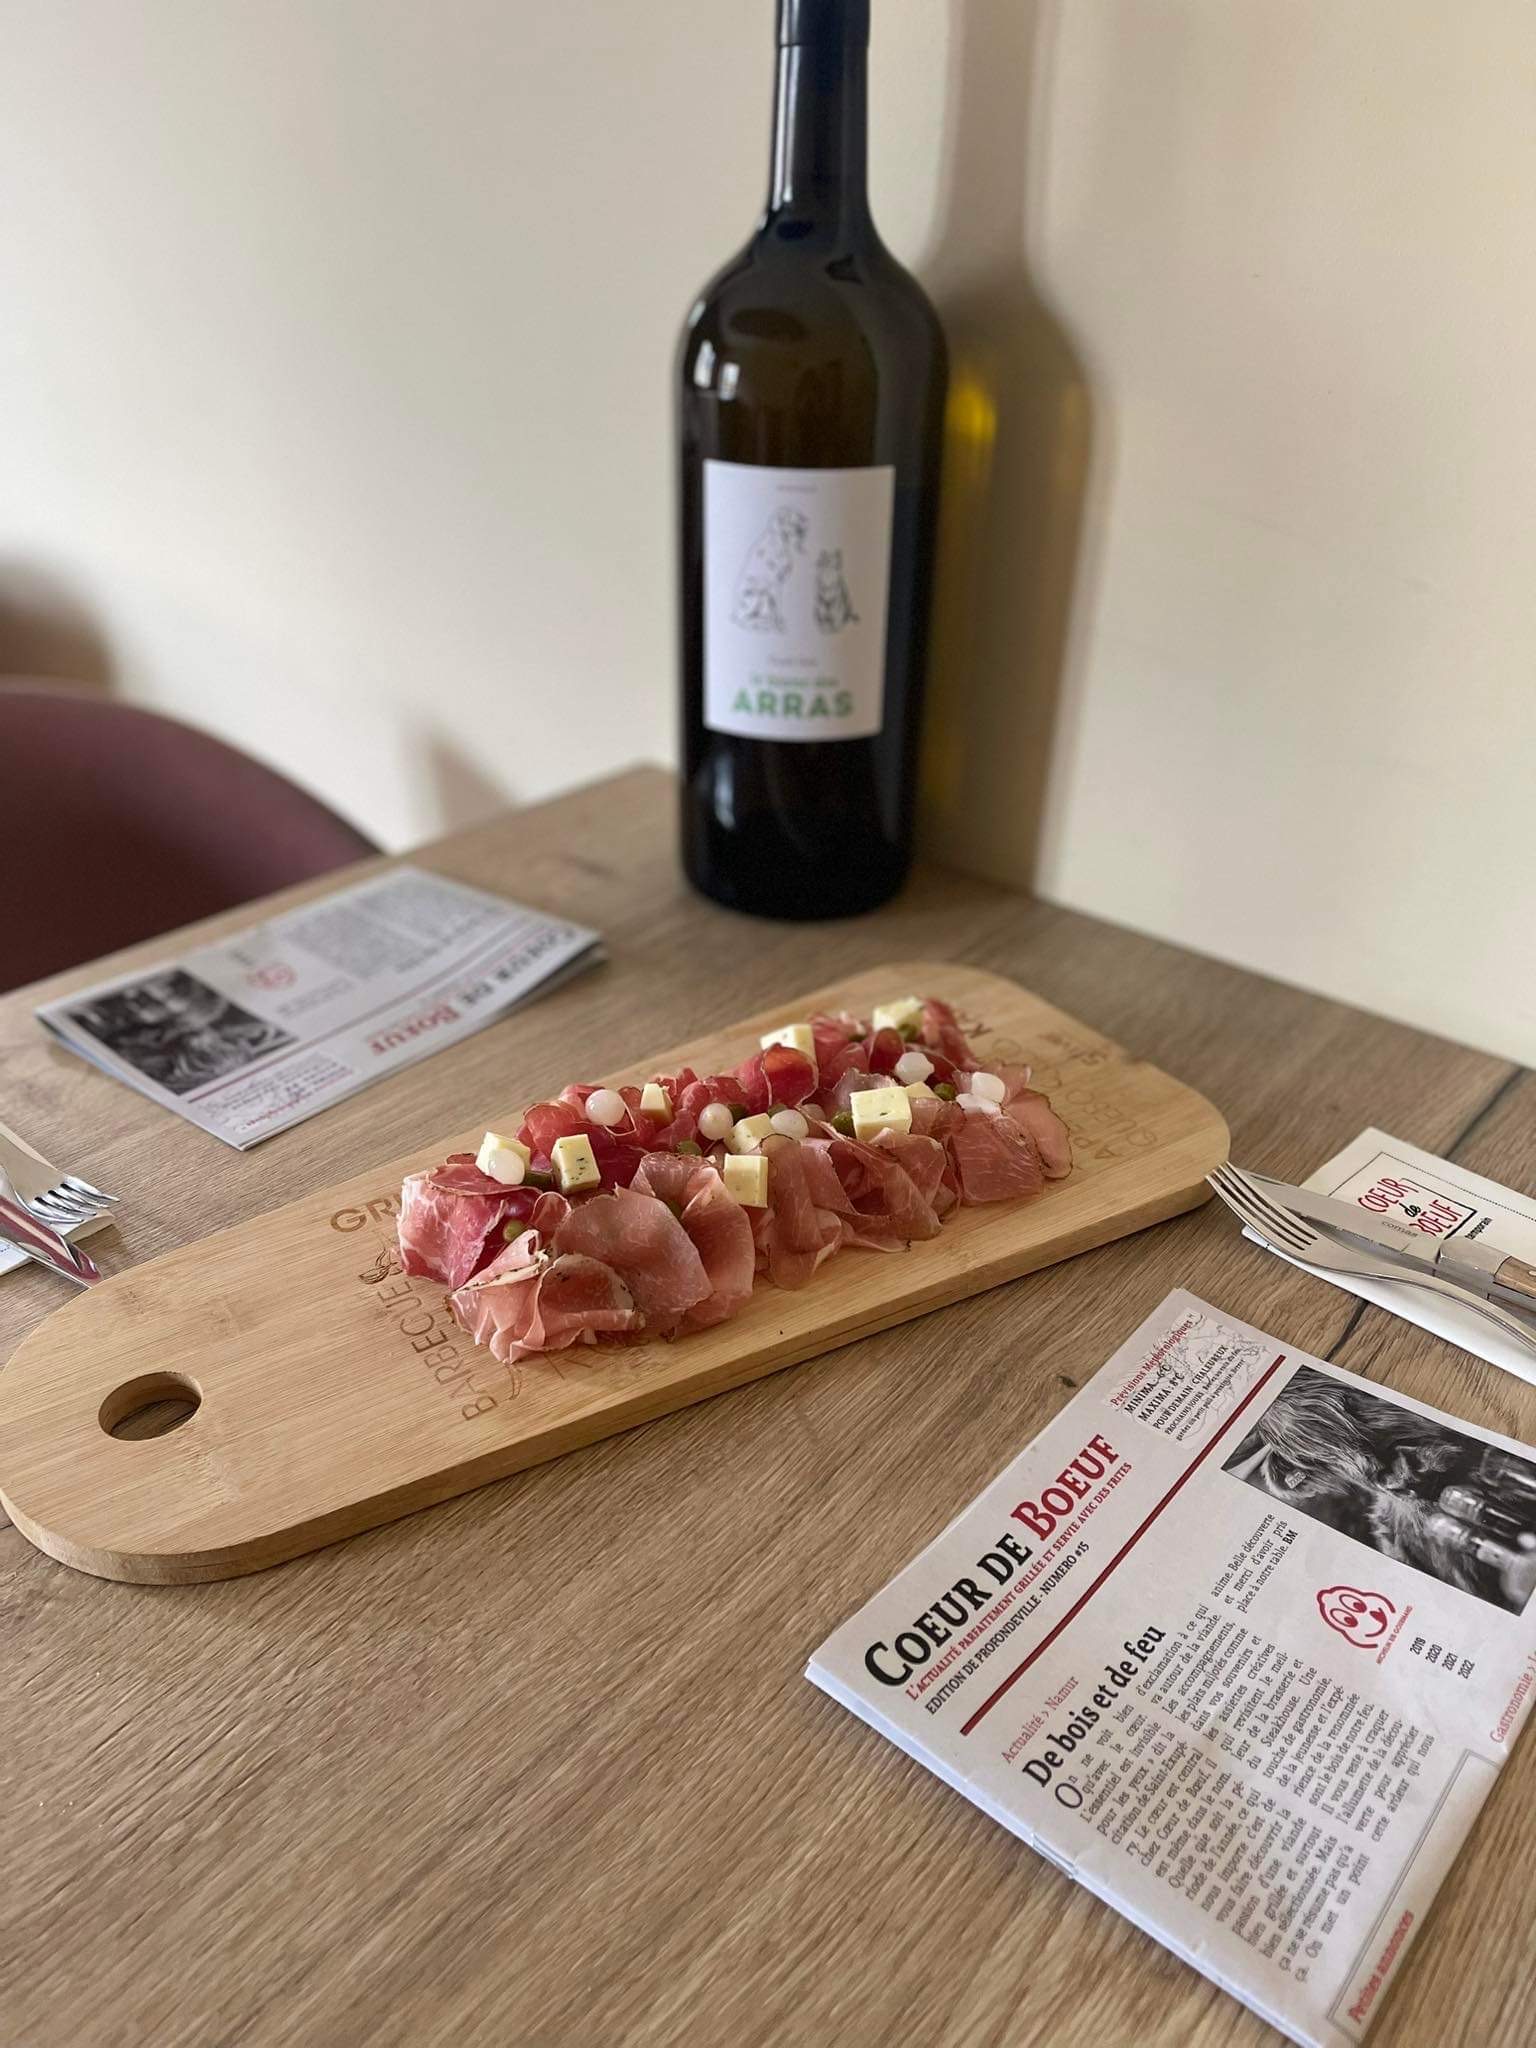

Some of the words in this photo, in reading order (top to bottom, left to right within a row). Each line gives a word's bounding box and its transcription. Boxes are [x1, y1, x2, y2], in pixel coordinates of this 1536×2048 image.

[732, 689, 854, 718] ARRAS
[1358, 1178, 1419, 1212] COEUR
[1399, 1203, 1421, 1217] de
[1123, 1382, 1157, 1413] MINIMA
[1137, 1388, 1171, 1421] MAXIMA
[1152, 1408, 1172, 1429] POUR
[1167, 1385, 1193, 1411] DEMAIN
[1191, 1344, 1228, 1384] CHALEUREUX
[864, 1578, 992, 1686] COEUR
[976, 1532, 1032, 1585] DE
[1010, 1433, 1118, 1541] BOEUF
[905, 1646, 961, 1700] L'ACTUALITÉ
[957, 1591, 1016, 1649] PARFAITEMENT
[1013, 1559, 1046, 1593] GRILLÉE
[1042, 1548, 1055, 1562] ET
[1052, 1521, 1080, 1551] SERVIE
[1077, 1502, 1097, 1523] AVEC
[1093, 1487, 1110, 1503] DES
[1106, 1462, 1131, 1488] FRITES
[1210, 1572, 1233, 1597] anime.
[1227, 1552, 1247, 1571] Belle
[1241, 1514, 1274, 1552] découverte
[1224, 1594, 1234, 1604] et
[1233, 1568, 1253, 1591] merci
[1250, 1538, 1273, 1565] d'avoir
[1272, 1520, 1287, 1537] pris
[1236, 1590, 1255, 1613] place
[1255, 1564, 1274, 1585] notre
[1269, 1545, 1288, 1565] table.
[1282, 1529, 1297, 1544] BM
[924, 1670, 966, 1714] EDITION
[961, 1658, 979, 1675] DE
[974, 1594, 1041, 1663] PROFONDEVILLE
[1039, 1554, 1076, 1594] NUMERO
[1123, 1626, 1165, 1662] feu
[1135, 1641, 1182, 1696] d'exclamation
[1186, 1620, 1197, 1631] ce
[1194, 1603, 1208, 1619] qui
[1150, 1694, 1162, 1703] va
[1159, 1663, 1183, 1693] autour
[1179, 1652, 1193, 1663] de
[1186, 1642, 1200, 1652] la
[1196, 1614, 1221, 1641] viande.
[1161, 1699, 1178, 1714] Les
[1177, 1622, 1235, 1696] accompagnements,
[1409, 1636, 1425, 1654] 2019
[1425, 1644, 1442, 1663] 2020
[1441, 1652, 1457, 1670] 2021
[1457, 1659, 1474, 1679] 2022
[1092, 1684, 1118, 1708] et
[1104, 1661, 1138, 1687] de
[1174, 1709, 1190, 1723] les
[1186, 1688, 1206, 1712] plats
[1202, 1657, 1227, 1689] mijotés
[1223, 1628, 1248, 1658] comme
[1190, 1710, 1210, 1731] dans
[1208, 1690, 1223, 1705] vos
[1222, 1647, 1253, 1688] souvenirs
[1251, 1635, 1261, 1645] et
[1202, 1727, 1219, 1741] les
[1218, 1684, 1247, 1722] assiettes
[1247, 1643, 1275, 1679] créatives
[1230, 1739, 1250, 1760] leur
[1246, 1725, 1260, 1737] de
[1254, 1713, 1269, 1723] la
[1262, 1671, 1295, 1710] brasserie
[1293, 1658, 1303, 1668] et
[1489, 1672, 1533, 1742] Gastronomie
[1001, 1714, 1044, 1763] Actualité
[1044, 1676, 1078, 1710] Namur
[1046, 1706, 1099, 1752] bois
[1080, 1753, 1093, 1767] ne
[1095, 1728, 1113, 1745] voit
[1112, 1704, 1134, 1722] bien
[1246, 1755, 1261, 1769] du
[1260, 1695, 1300, 1747] Steakhouse.
[1298, 1667, 1317, 1685] Une
[1021, 1750, 1063, 1787] De
[1081, 1759, 1111, 1794] qu'avec
[1109, 1743, 1123, 1753] le
[1096, 1807, 1117, 1836] pour
[1112, 1791, 1129, 1807] les
[1128, 1766, 1149, 1792] yeux
[1151, 1741, 1166, 1755] dit
[1160, 1731, 1175, 1741] la
